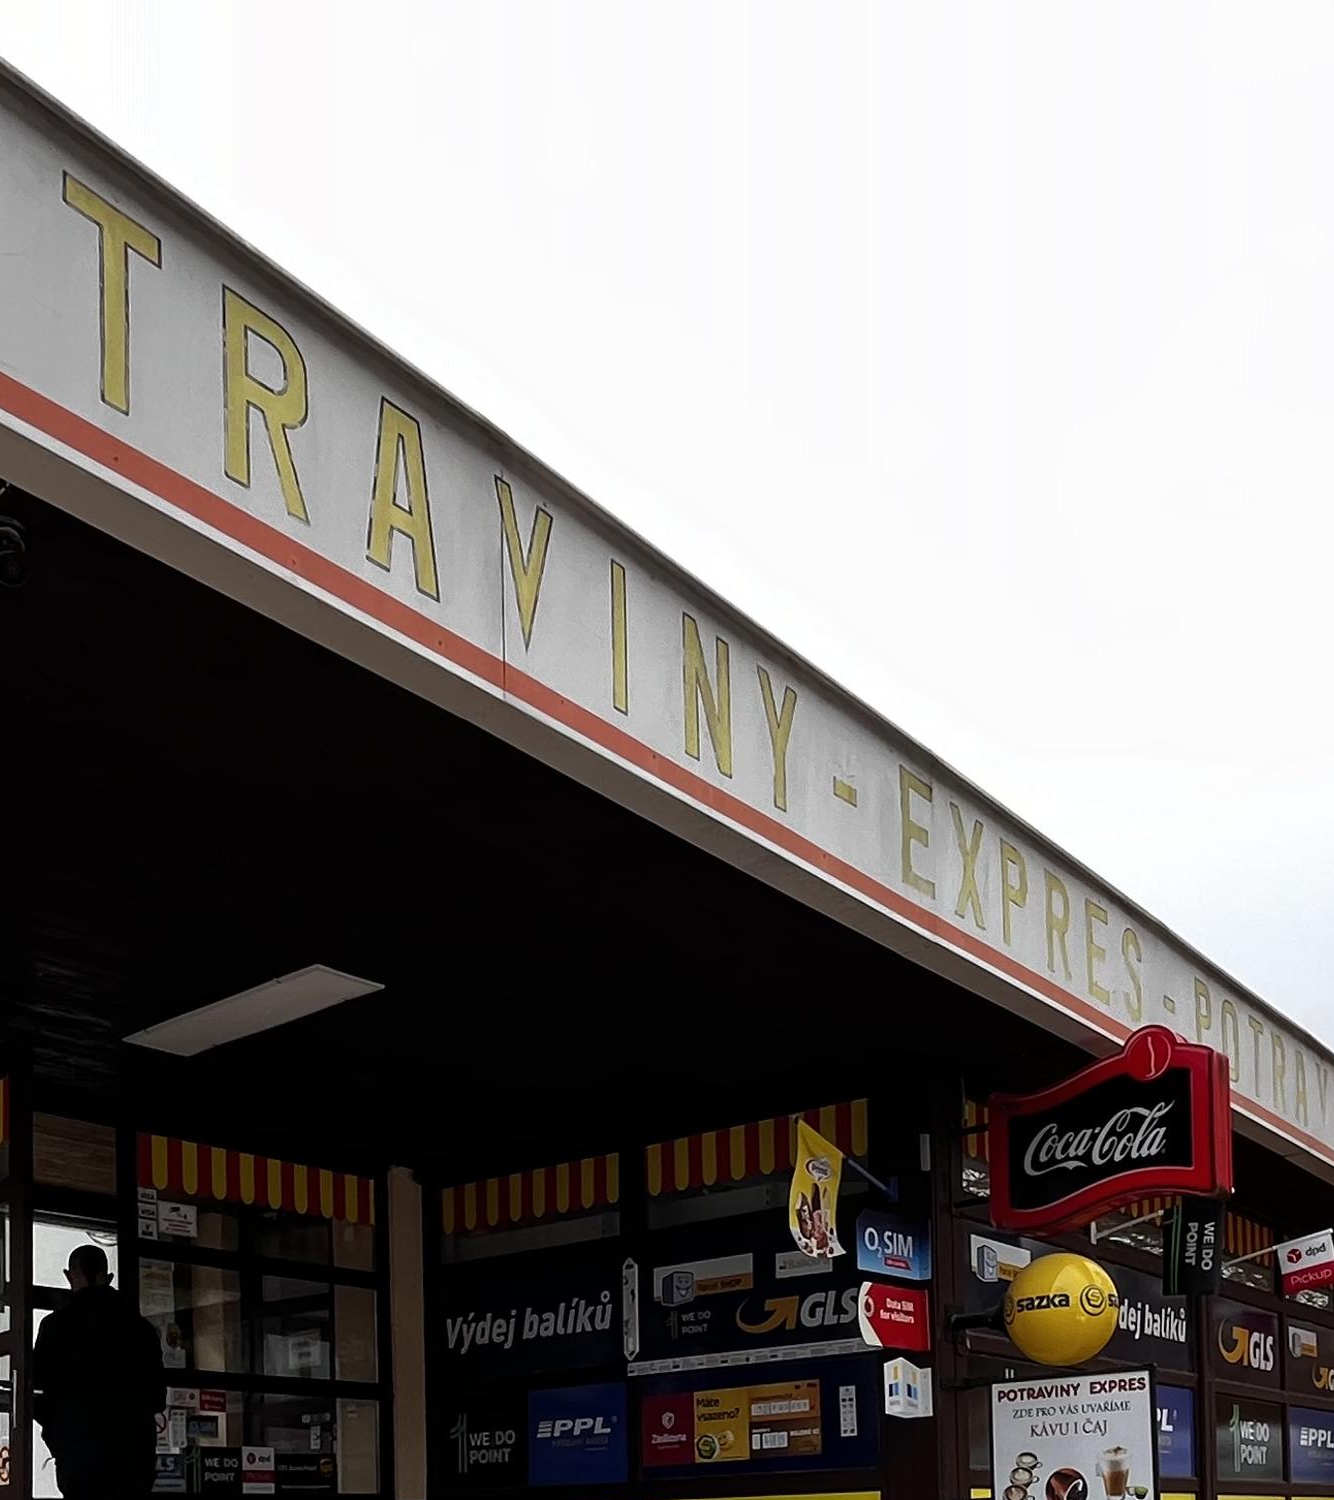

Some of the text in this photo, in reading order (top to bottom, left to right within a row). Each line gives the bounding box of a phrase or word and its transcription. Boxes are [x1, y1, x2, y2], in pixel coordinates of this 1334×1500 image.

[898, 764, 1143, 1024] EXPRES
[883, 1229, 914, 1259] SIM
[1184, 1222, 1199, 1266] POINT
[1200, 1221, 1216, 1271] WE DO
[1305, 1243, 1327, 1258] dpd
[1289, 1268, 1333, 1287] Pickup
[800, 1288, 859, 1329] GLS
[1016, 1293, 1070, 1313] sazka
[446, 1290, 613, 1356] Výdej balíků
[1144, 1304, 1187, 1344] balíků
[1249, 1331, 1275, 1372] GLS
[998, 1377, 1147, 1404] POTRAVINY EXPRES
[1012, 1408, 1034, 1420] ZDE
[1057, 1403, 1079, 1416] VÁS
[1081, 1400, 1131, 1415] UVAŘÍME
[469, 1429, 517, 1447] WE DO
[551, 1416, 612, 1438] PPL
[1030, 1420, 1070, 1438] KÁVU
[1082, 1419, 1108, 1438] ČAJ
[1239, 1420, 1254, 1441] WE
[468, 1447, 512, 1465] POINT
[1240, 1444, 1267, 1465] POINT
